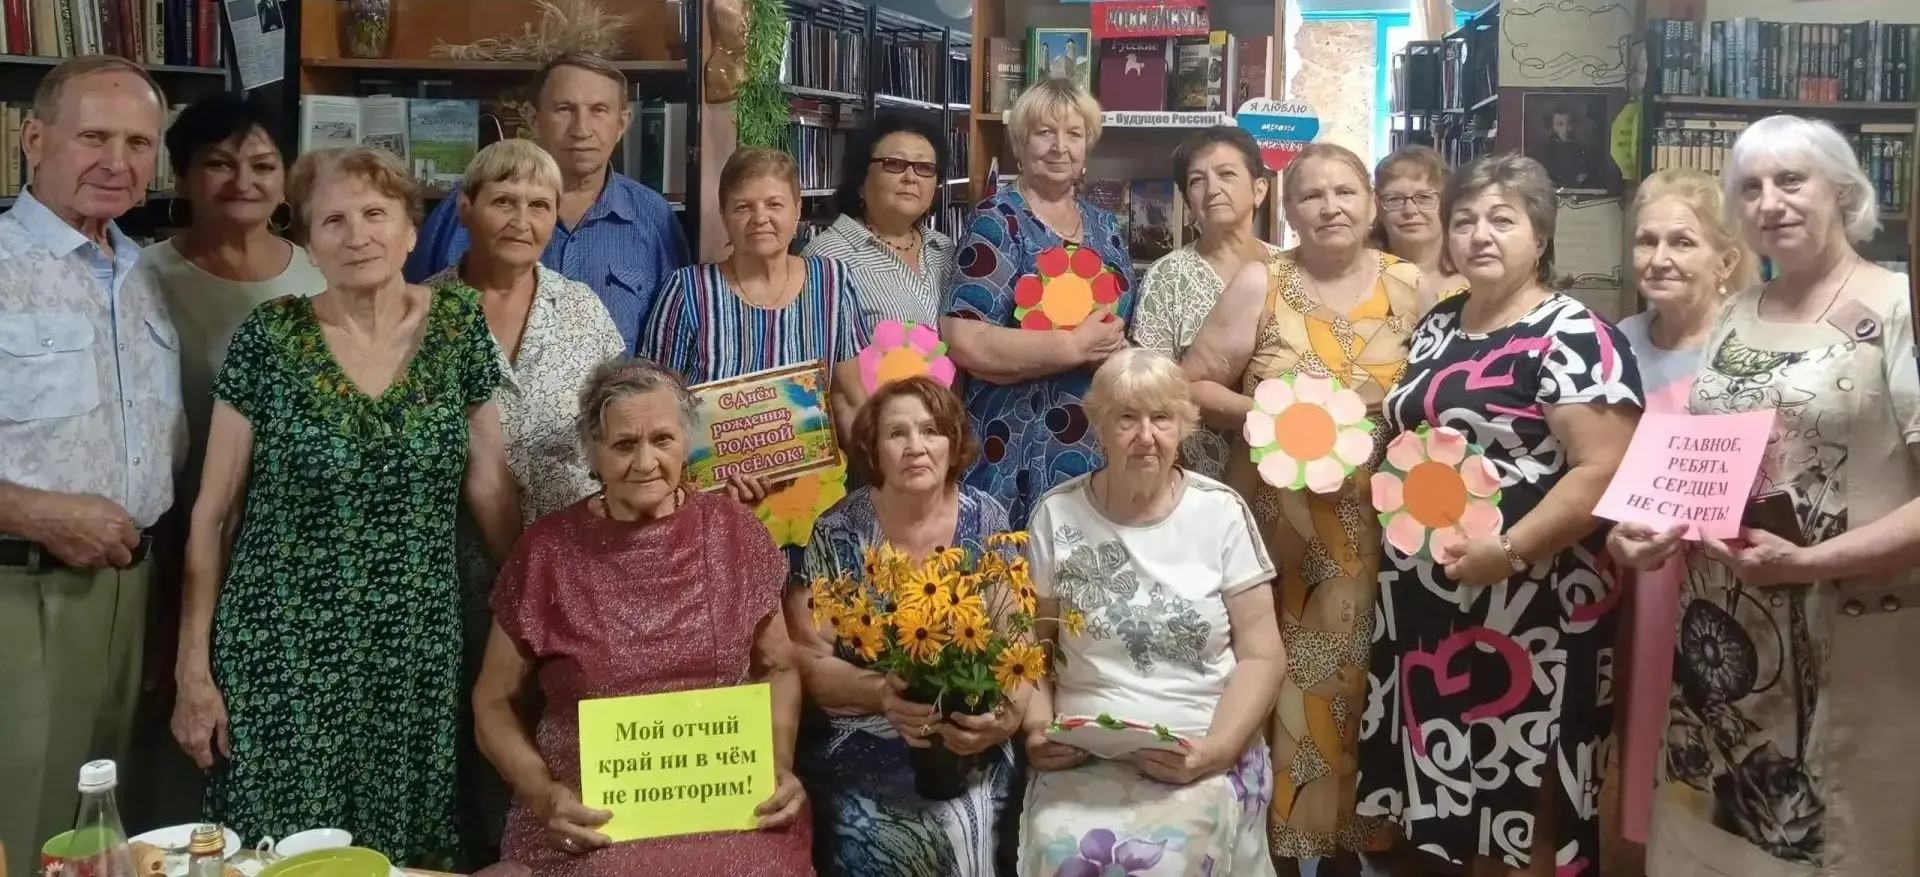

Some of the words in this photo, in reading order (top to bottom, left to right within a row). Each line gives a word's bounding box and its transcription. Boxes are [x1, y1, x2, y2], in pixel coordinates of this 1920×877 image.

[1116, 113, 1169, 126] будущее
[1172, 113, 1216, 124] России
[1250, 102, 1258, 111] Я
[1261, 103, 1307, 113] ЛЮБЛЮ
[719, 393, 735, 409] С
[735, 387, 777, 409] Днём
[711, 408, 791, 439] рождения,
[715, 424, 795, 457] РОДНОЙ
[1668, 435, 1741, 453] ГЛАВНОЕ,
[712, 446, 805, 481] ПОСЁЛОК!
[1653, 476, 1729, 497] СЕРДЦЕМ
[1626, 494, 1654, 511] НЕ
[1657, 501, 1730, 522] СТАРЕТЬ!
[616, 720, 664, 742] Мой
[672, 716, 739, 738] отчий
[598, 752, 652, 778] край
[660, 754, 688, 770] ни
[696, 754, 708, 767] в
[716, 747, 756, 765] чём
[603, 789, 627, 805] не
[634, 775, 753, 803] повторим!
